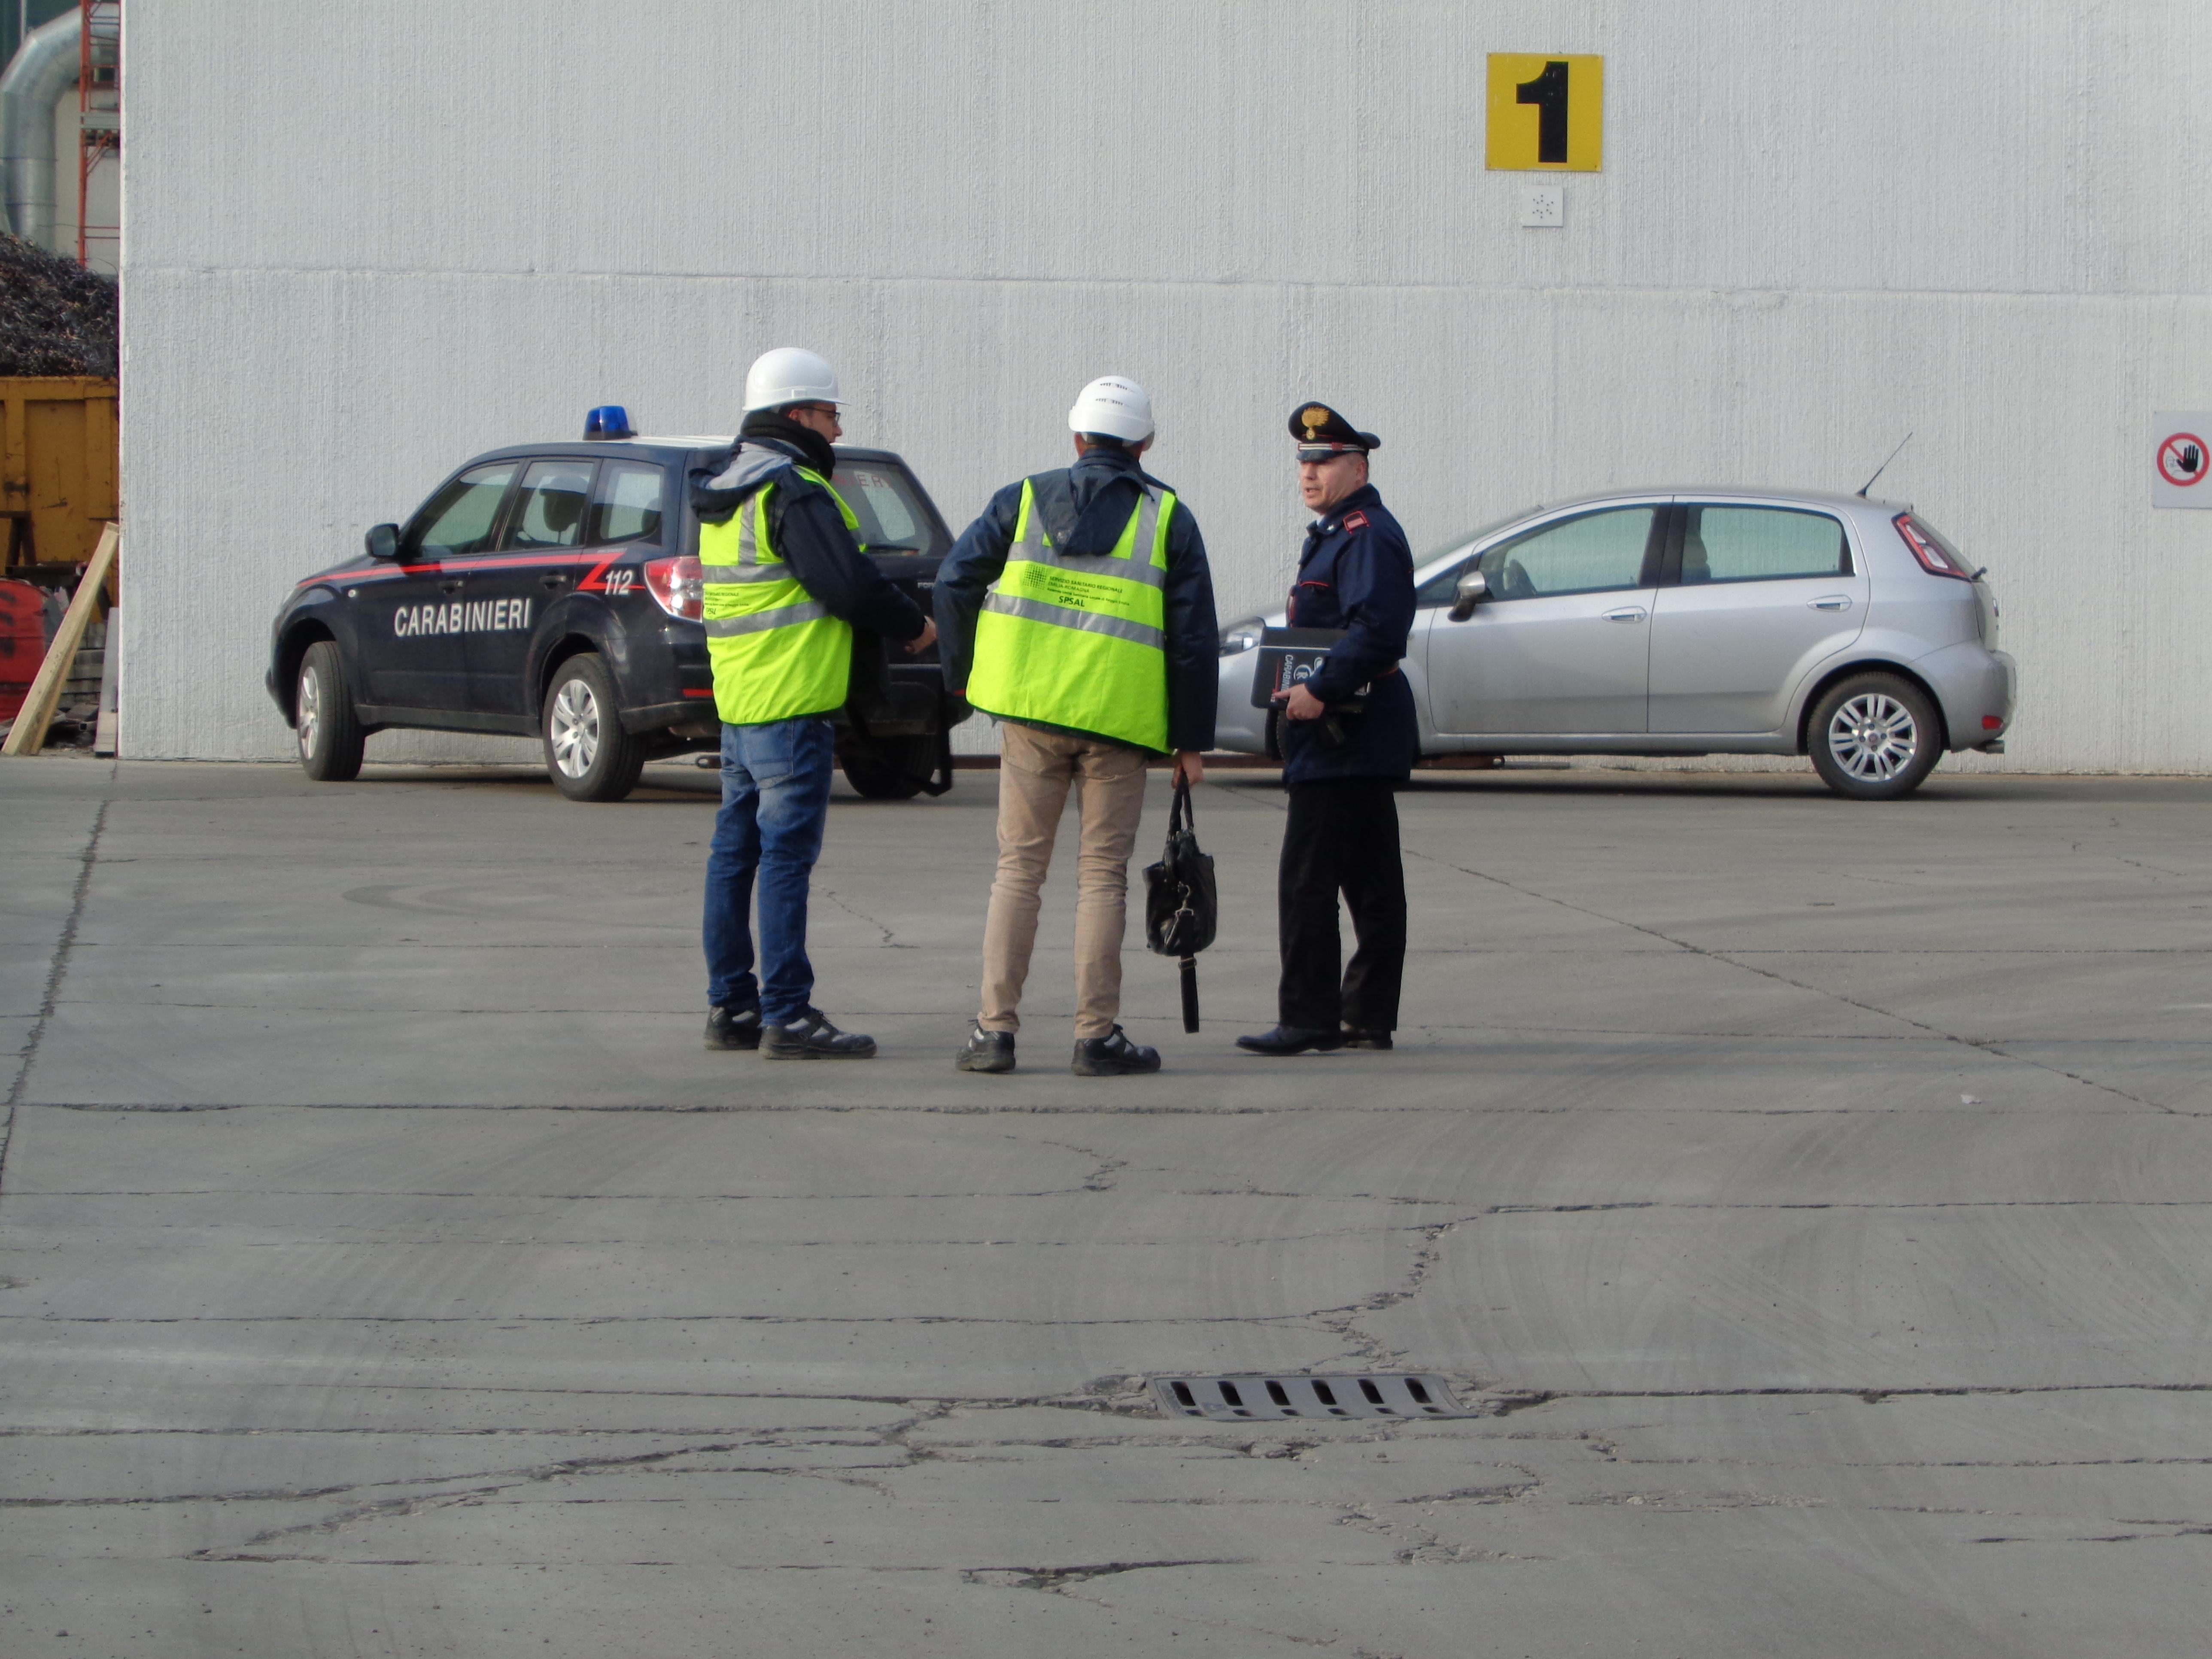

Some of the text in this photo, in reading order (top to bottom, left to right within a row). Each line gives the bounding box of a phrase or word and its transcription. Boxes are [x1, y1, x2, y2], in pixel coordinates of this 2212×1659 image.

[1516, 61, 1568, 163] 1
[605, 570, 633, 595] 112
[1071, 580, 1096, 588] SANITARIO
[1097, 584, 1122, 593] REGIONALE
[1058, 596, 1085, 607] SPSAL
[394, 597, 530, 637] CARABINIERI
